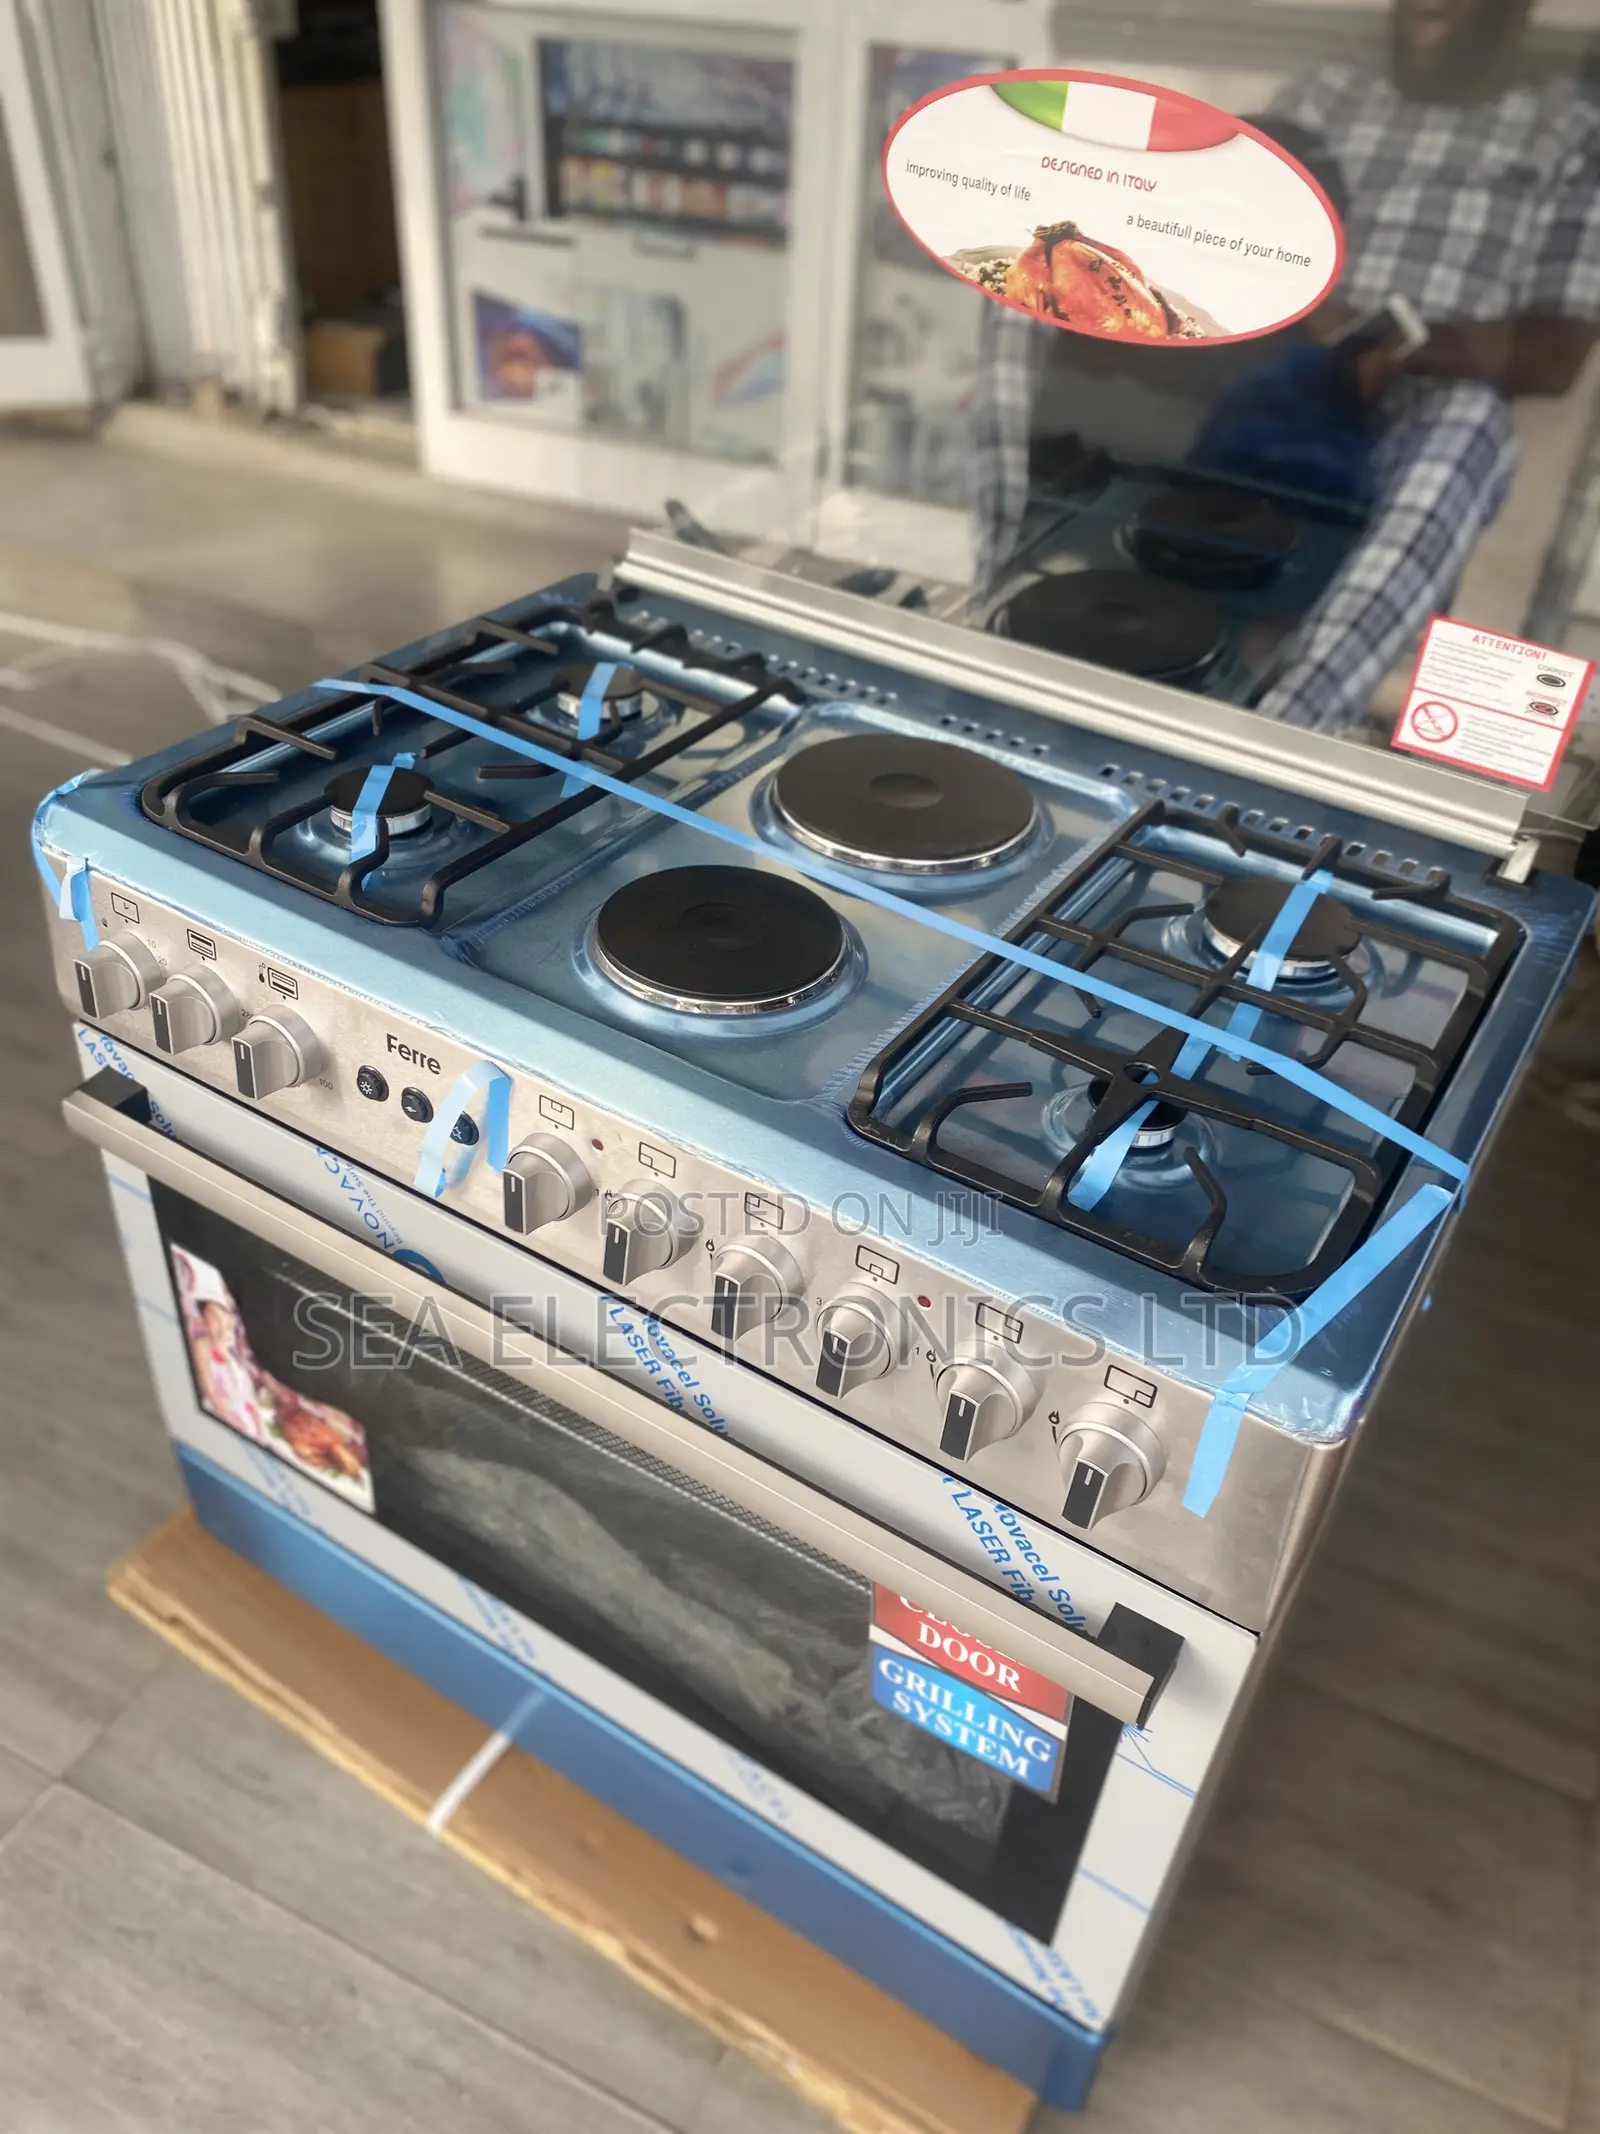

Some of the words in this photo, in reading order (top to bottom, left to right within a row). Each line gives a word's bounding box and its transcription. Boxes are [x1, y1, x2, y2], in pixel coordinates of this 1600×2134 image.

[906, 158, 958, 187] improving
[961, 176, 998, 196] quality
[1000, 183, 1013, 197] of
[1014, 185, 1031, 201] life
[1041, 156, 1103, 180] DESIGNED
[1106, 170, 1119, 184] IN
[1123, 173, 1158, 192] ITALY
[1126, 214, 1133, 225] a
[1137, 213, 1192, 239] beautifull
[1194, 228, 1226, 247] piece
[1229, 237, 1244, 251] of
[1244, 242, 1274, 258] your
[1276, 247, 1311, 267] home
[1471, 634, 1548, 661] ATTENTION!
[386, 1033, 441, 1075] Ferre
[319, 1077, 334, 1090] 100
[609, 1306, 662, 1376] LASER
[656, 1377, 687, 1412] Fib
[951, 1490, 1011, 1564] LASER
[916, 1620, 1021, 1694] DOOR
[879, 1658, 1052, 1763] GRILLING
[892, 1690, 1031, 1778] SYSTEM
